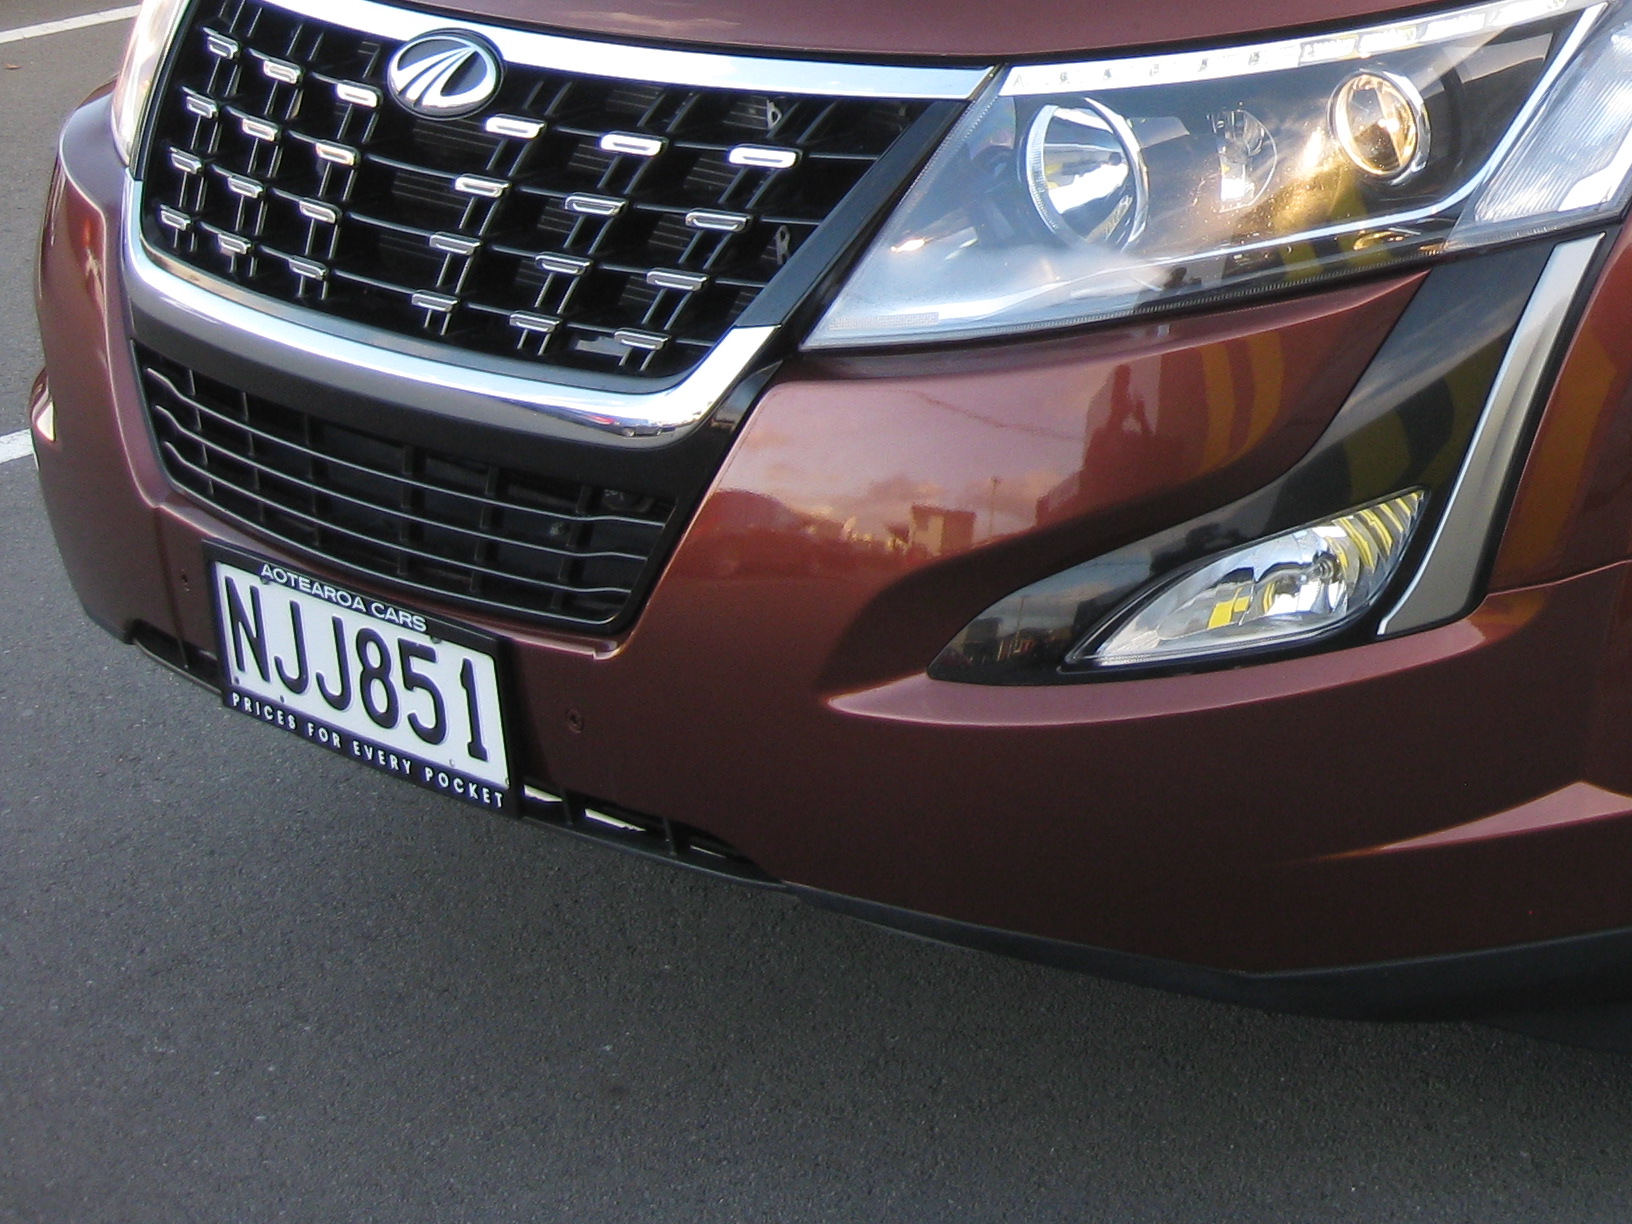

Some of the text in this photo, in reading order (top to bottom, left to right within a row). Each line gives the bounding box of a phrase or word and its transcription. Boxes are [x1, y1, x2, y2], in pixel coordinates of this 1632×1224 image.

[261, 563, 427, 632] AOTEAROA CARS
[225, 575, 489, 762] NJJ851
[232, 692, 504, 808] PRICES FOR EVERY POCKET
